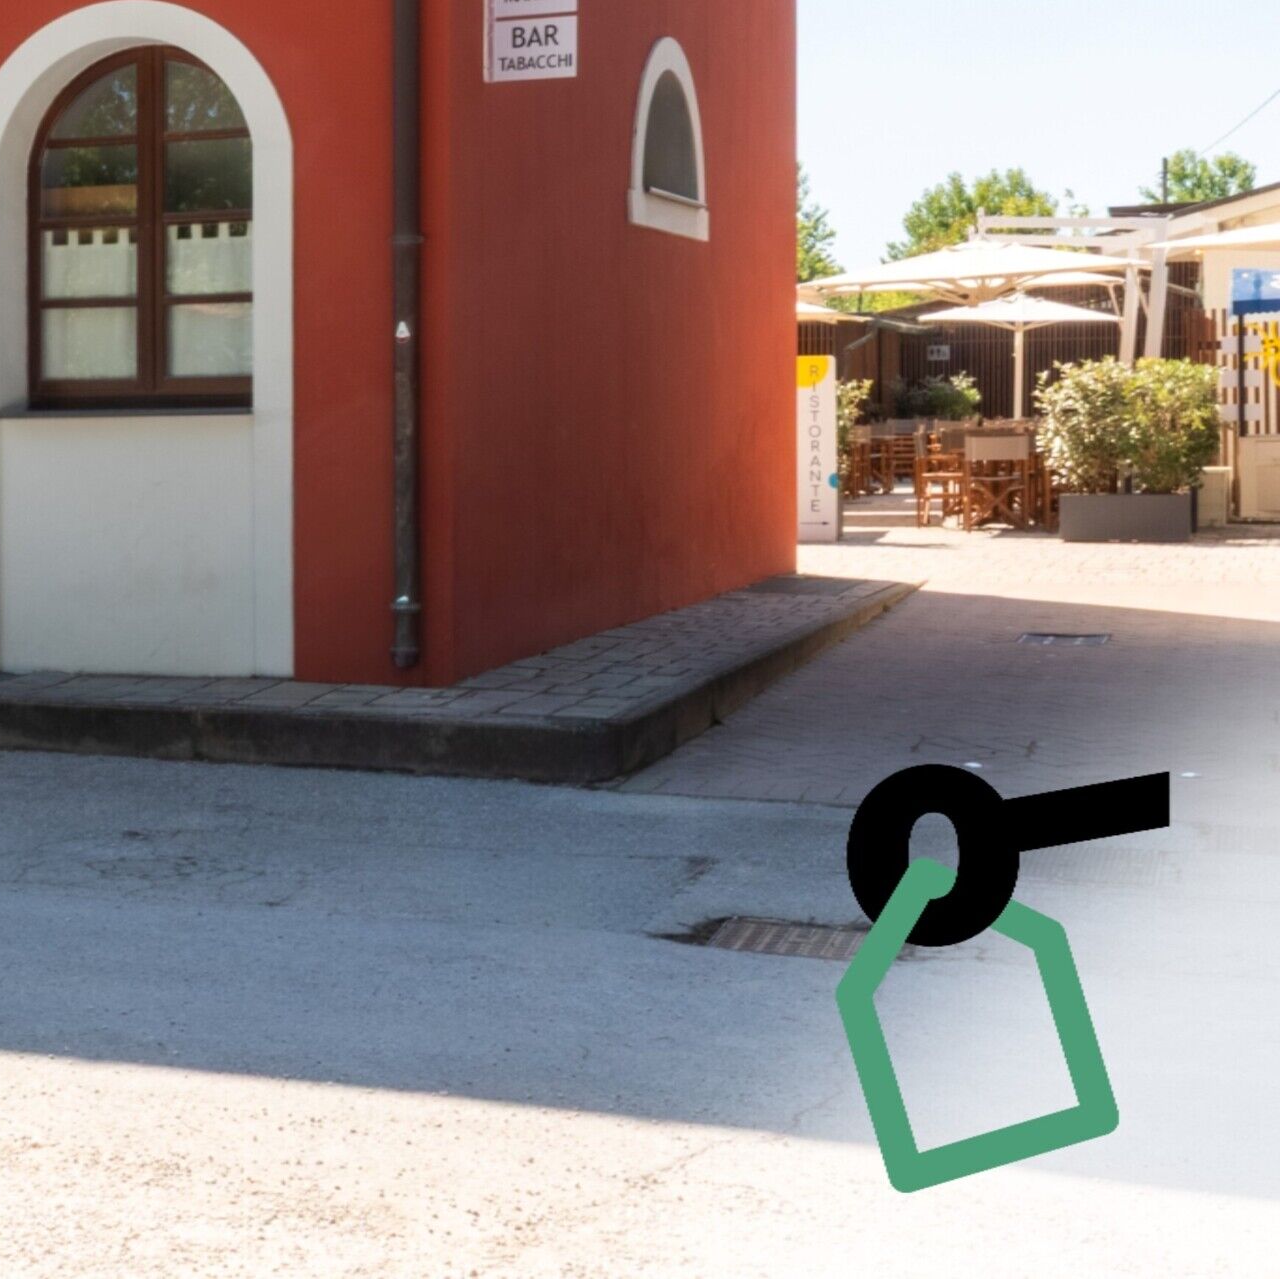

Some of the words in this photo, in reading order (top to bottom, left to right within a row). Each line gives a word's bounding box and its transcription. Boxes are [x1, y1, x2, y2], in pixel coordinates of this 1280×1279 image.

[512, 24, 559, 49] BAR
[498, 53, 572, 72] TABACCHI
[808, 364, 822, 513] RISTORANTE
